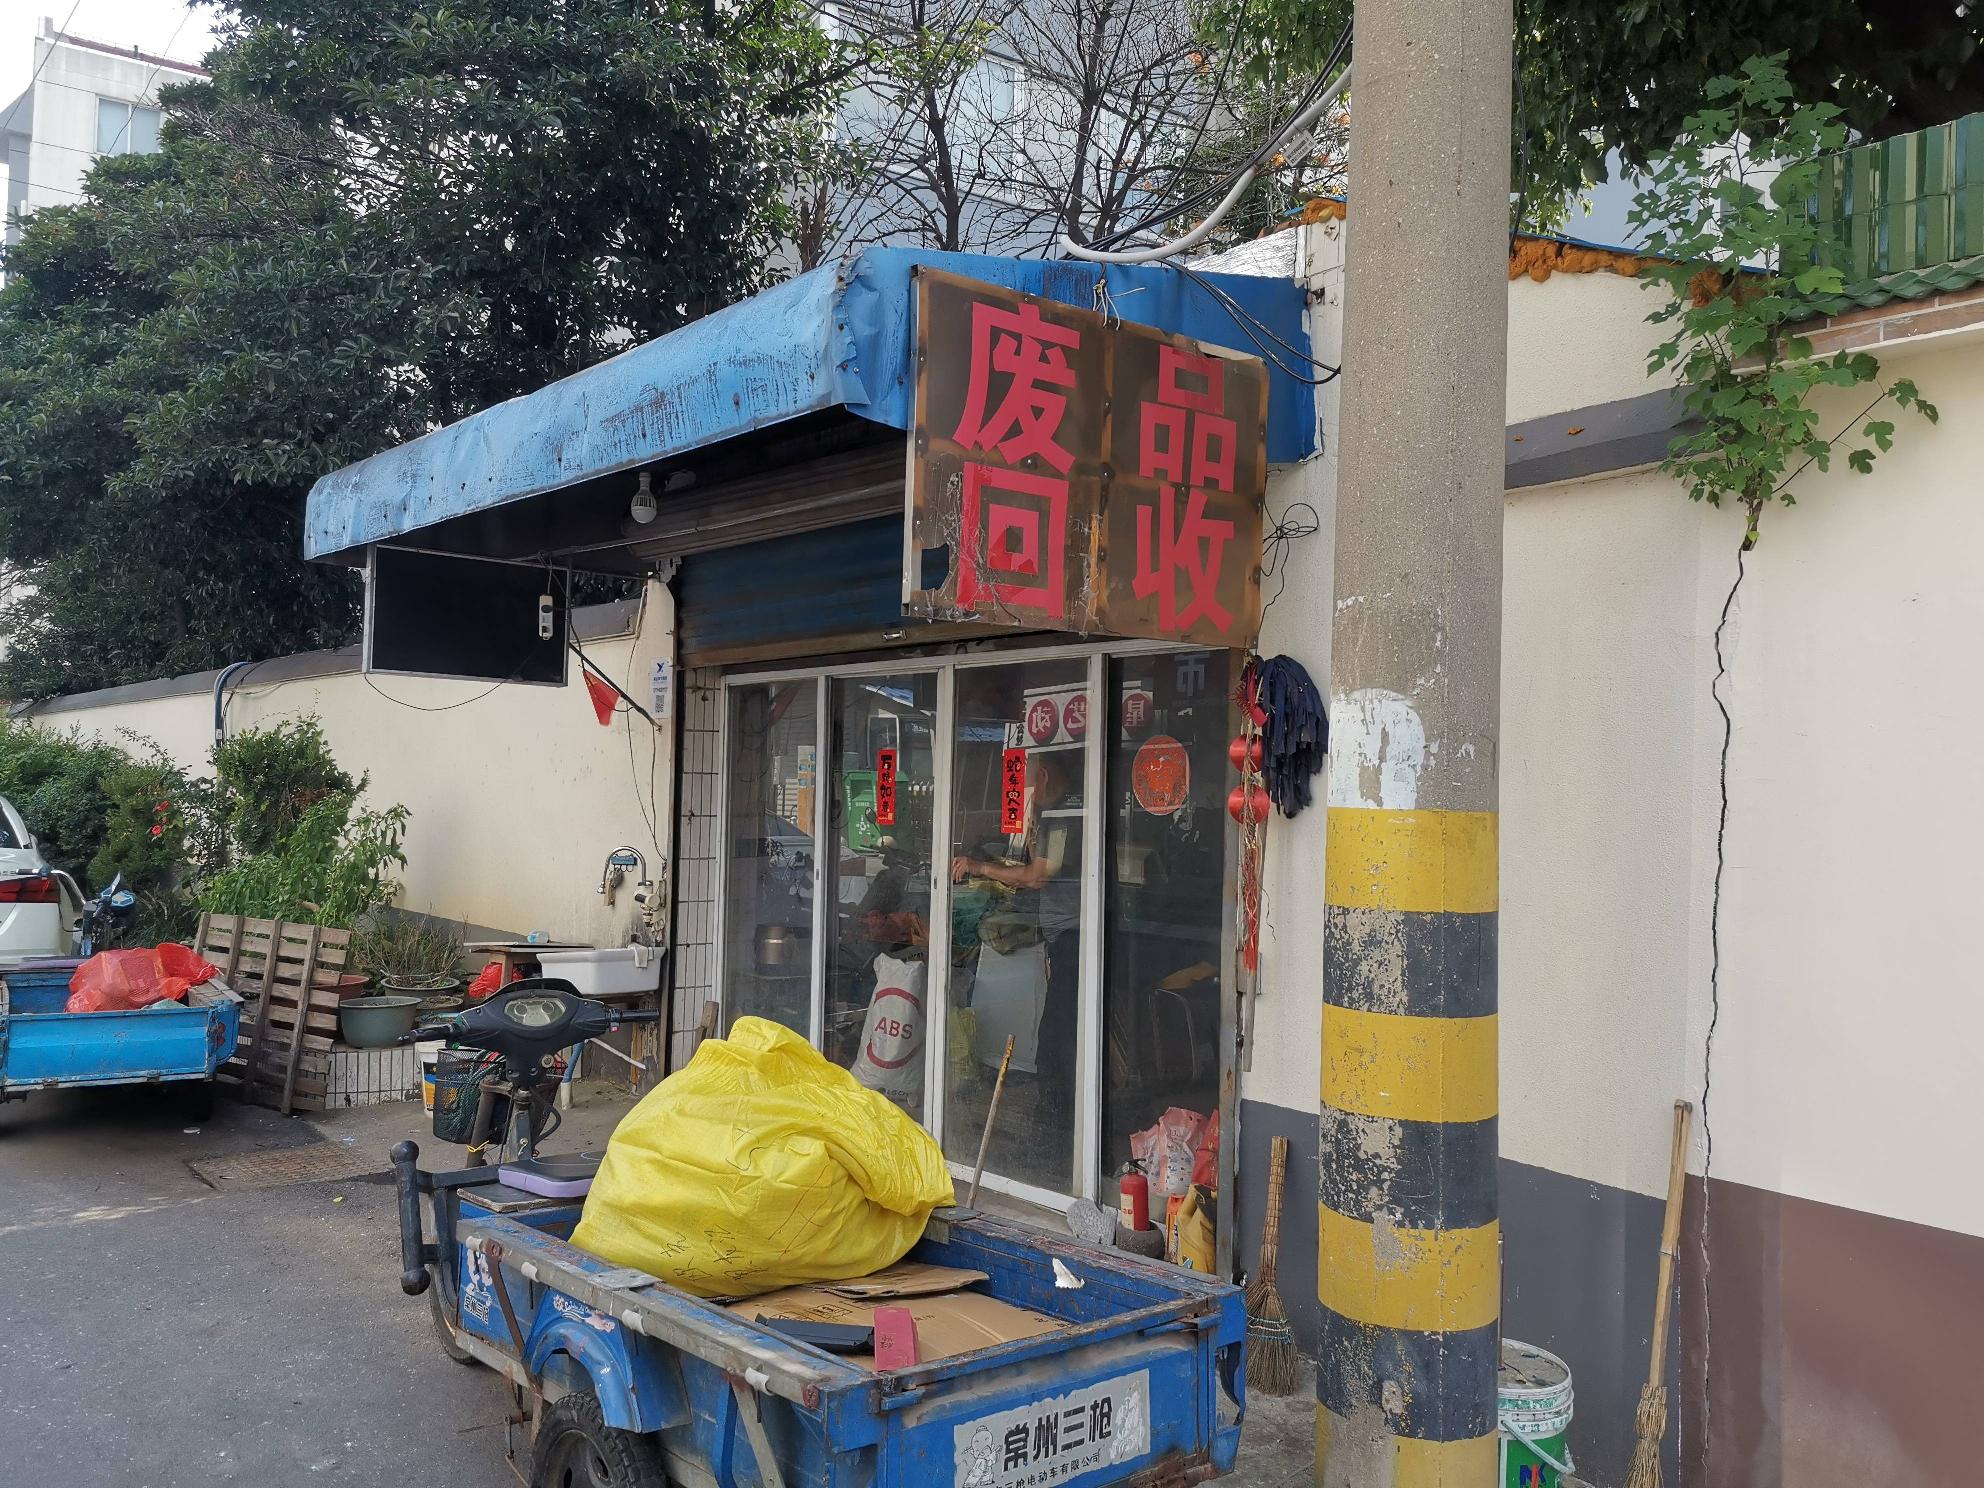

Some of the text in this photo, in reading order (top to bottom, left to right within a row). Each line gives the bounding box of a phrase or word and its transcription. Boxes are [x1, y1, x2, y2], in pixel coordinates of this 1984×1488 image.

[952, 301, 1236, 493] 废品
[957, 461, 1234, 634] 回收
[874, 1016, 913, 1040] ABS
[995, 1448, 1101, 1488] 三枪电动车有限公司
[1003, 1396, 1113, 1472] 常州三枪
